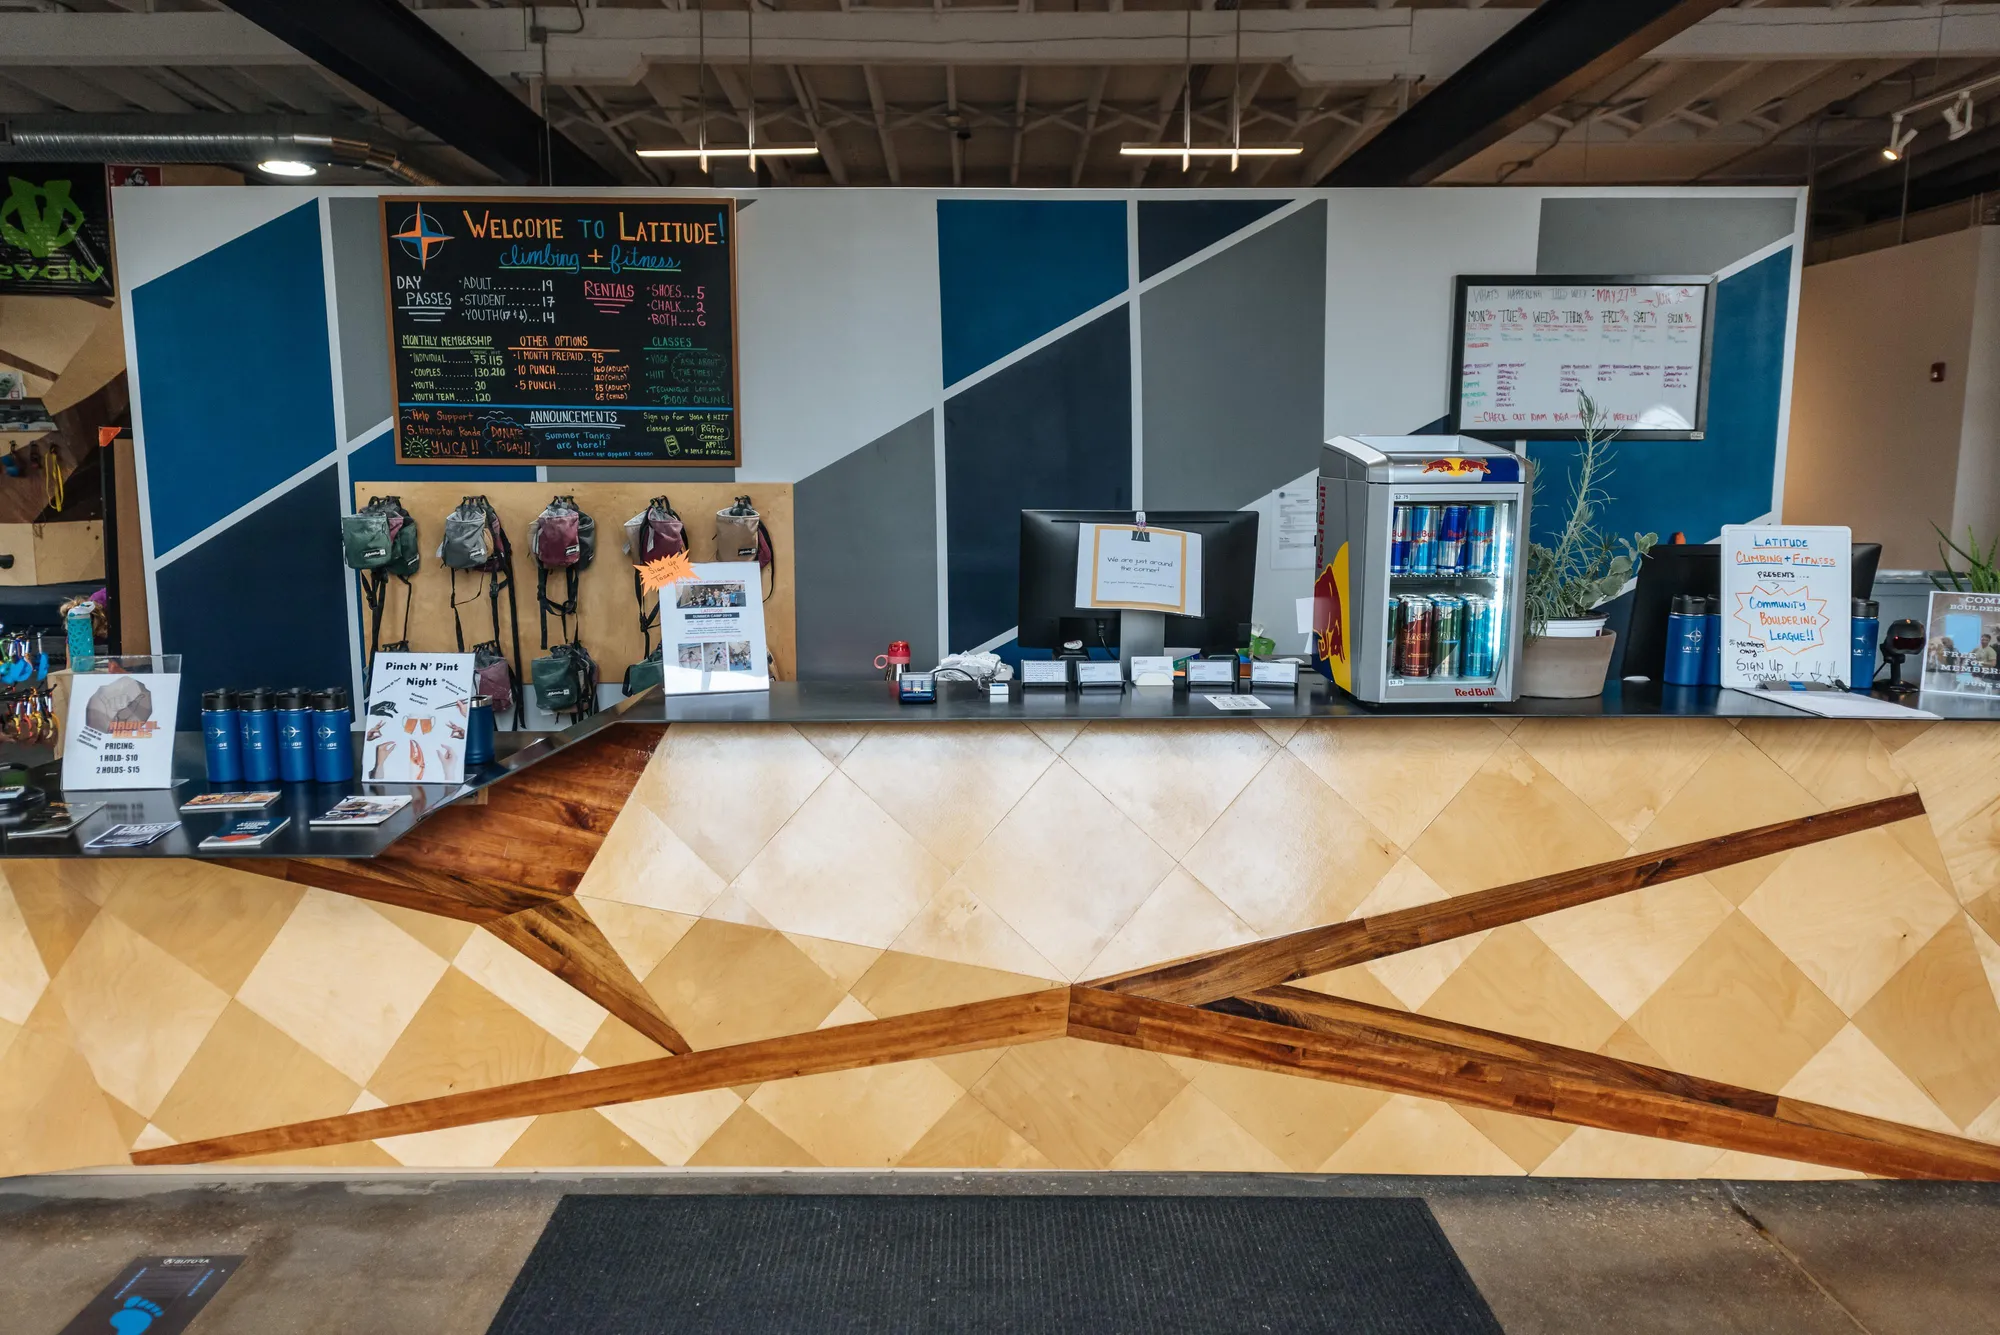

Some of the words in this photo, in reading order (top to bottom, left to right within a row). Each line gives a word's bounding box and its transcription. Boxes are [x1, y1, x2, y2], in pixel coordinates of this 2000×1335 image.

[462, 210, 564, 239] WELCOME
[577, 218, 605, 239] TO
[618, 210, 726, 245] LATITUDE!
[499, 243, 581, 274] climbing
[609, 245, 682, 274] fitness
[396, 275, 422, 290] DAY
[584, 279, 635, 298] RENTALS
[405, 292, 452, 306] PASSES
[1596, 288, 1616, 304] MAY
[1468, 310, 1486, 322] MON
[1498, 309, 1518, 323] TUE
[1532, 311, 1551, 323] WED
[1601, 310, 1620, 323] FRI
[1633, 310, 1651, 323] SAT
[1667, 312, 1684, 324] SUN
[402, 334, 438, 347] MONTHLY
[441, 335, 493, 347] MEMBERSHIP
[519, 335, 549, 347] OTHER
[554, 335, 589, 347] OPTIONS
[652, 336, 692, 348] CLASSES
[523, 351, 549, 360] MONTH
[517, 365, 526, 376] 10
[529, 364, 556, 376] PUNCH
[475, 380, 487, 391] 30
[519, 380, 527, 390] 5
[528, 380, 556, 391] PUNCH
[413, 393, 434, 401] YOUTH
[412, 410, 430, 423] Help
[436, 410, 474, 423] Support
[529, 410, 618, 424] ANNOUNCEMENTS
[643, 411, 658, 423] Sign
[671, 411, 685, 421] for
[1483, 411, 1508, 423] CHECK
[1512, 413, 1526, 421] OUT
[490, 425, 523, 439] DONATE
[544, 431, 580, 441] Summer
[583, 431, 612, 440] Tanks
[646, 424, 672, 432] classes
[675, 424, 695, 436] using
[556, 441, 572, 450] are
[1753, 533, 1809, 548] LATITUDE
[1135, 558, 1148, 566] just
[1735, 550, 1783, 563] CLIMBING
[1791, 553, 1836, 566] FITNESS
[1759, 611, 1817, 626] BOULDERING
[1769, 628, 1815, 642] LEAGUE!!
[1942, 650, 1977, 659] FREE
[385, 662, 417, 671] Pinch
[435, 662, 459, 671] Pint
[1735, 657, 1764, 672] SIGN
[406, 677, 438, 688] Night
[1454, 688, 1475, 697] Red
[1475, 687, 1494, 696] Bull
[104, 742, 135, 750] PRICING:
[125, 754, 139, 762] $10
[127, 766, 140, 774] $15
